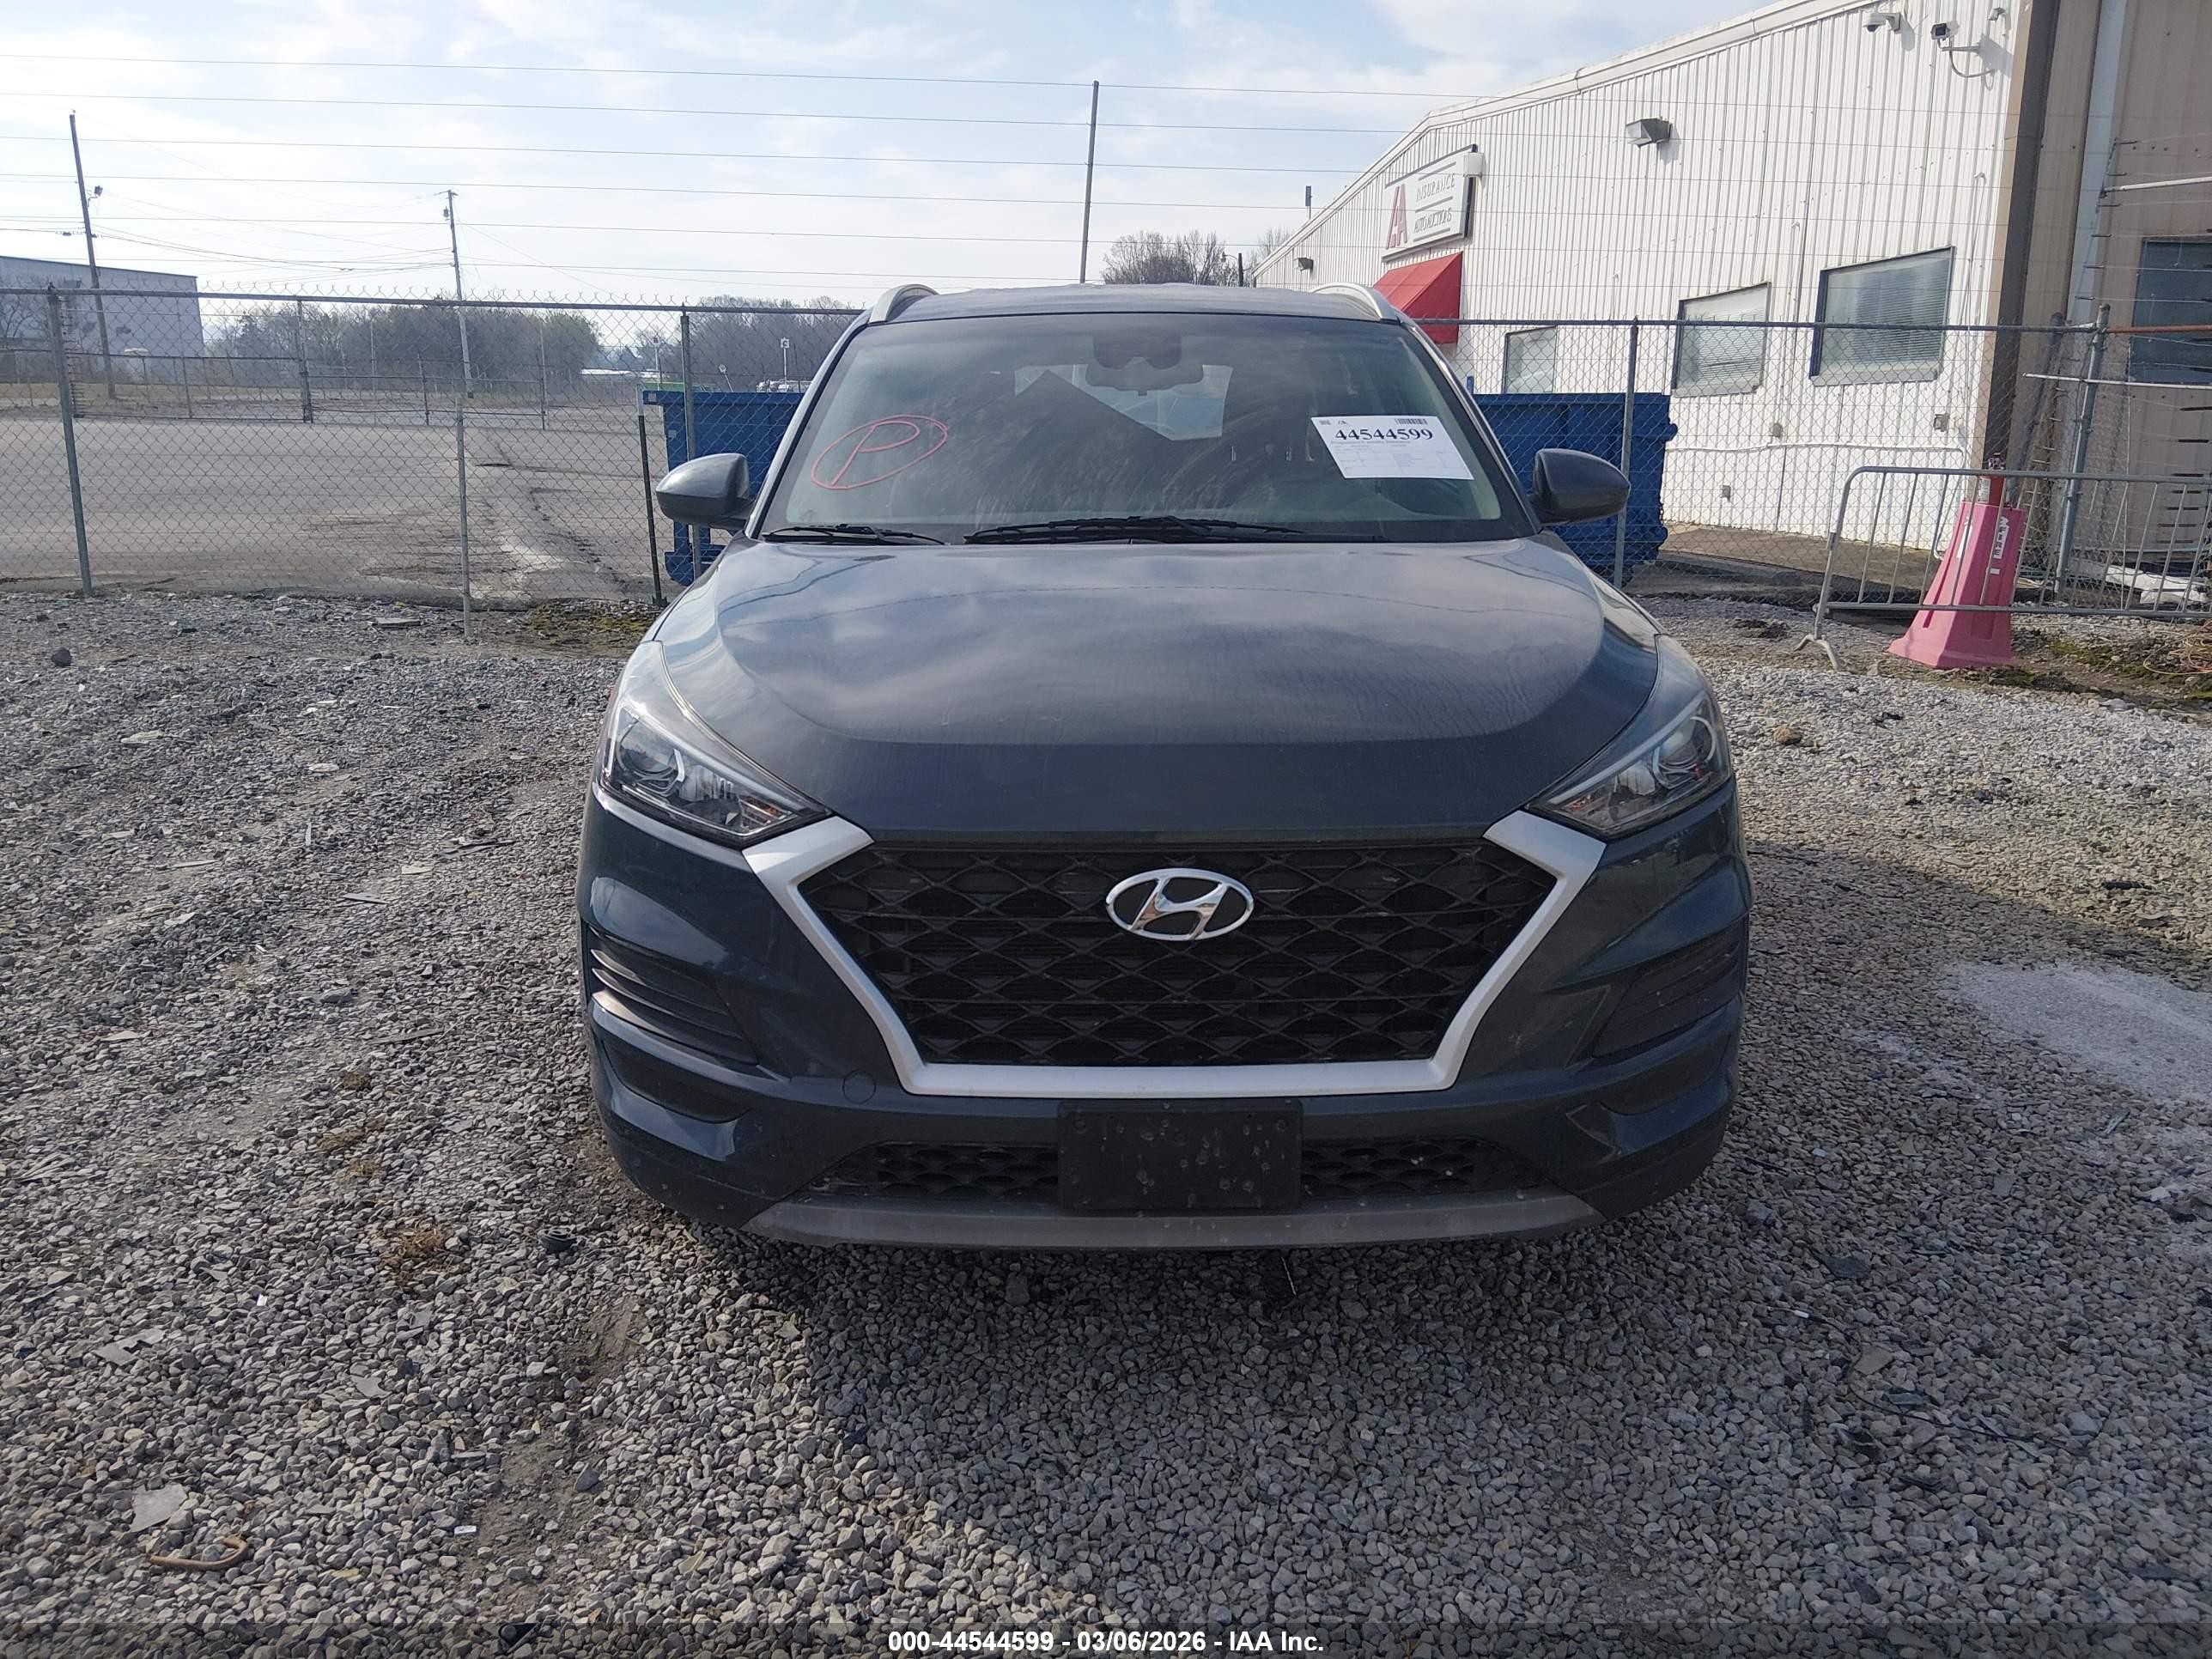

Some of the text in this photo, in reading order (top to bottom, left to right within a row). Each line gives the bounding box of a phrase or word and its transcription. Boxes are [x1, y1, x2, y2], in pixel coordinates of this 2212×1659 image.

[1416, 173, 1456, 203] INSURANCE
[1335, 428, 1433, 441] 44544599
[831, 420, 921, 487] P
